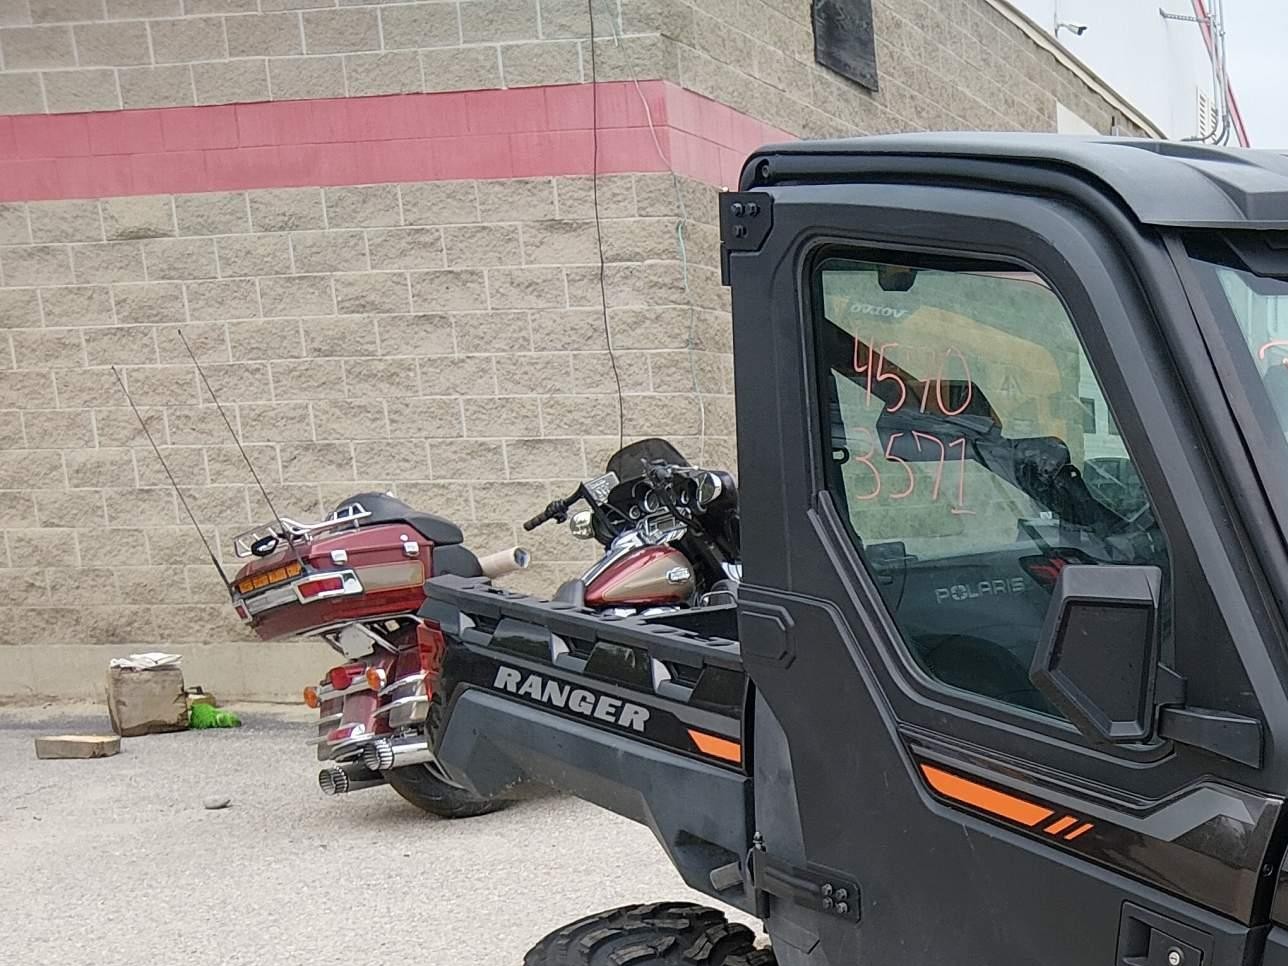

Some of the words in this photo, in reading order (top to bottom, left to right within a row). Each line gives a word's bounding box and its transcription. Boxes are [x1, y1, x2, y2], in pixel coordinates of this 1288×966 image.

[853, 328, 972, 416] 4570
[853, 427, 977, 515] 3571
[935, 577, 1025, 604] POLARIS
[493, 665, 650, 732] RANGER
